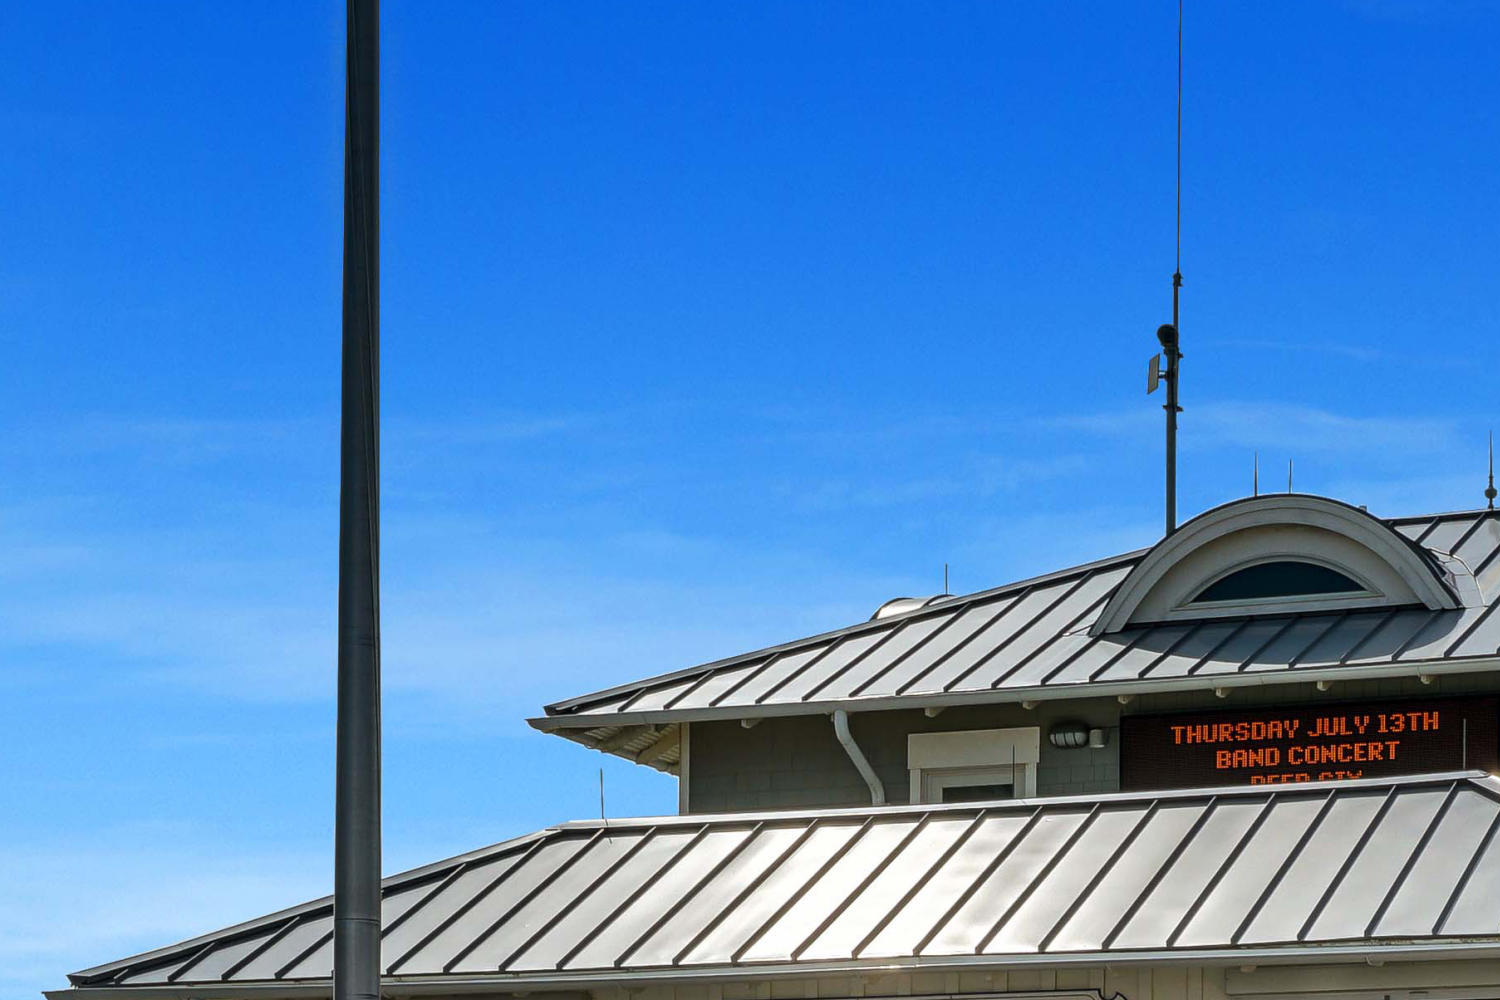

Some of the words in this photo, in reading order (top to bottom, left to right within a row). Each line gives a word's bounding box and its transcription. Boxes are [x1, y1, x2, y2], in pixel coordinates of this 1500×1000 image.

[1171, 720, 1299, 745] THURSDAY
[1307, 715, 1370, 737] JULY
[1378, 711, 1439, 733] 13TH
[1216, 747, 1280, 769] BAND
[1288, 741, 1400, 764] CONCERT
